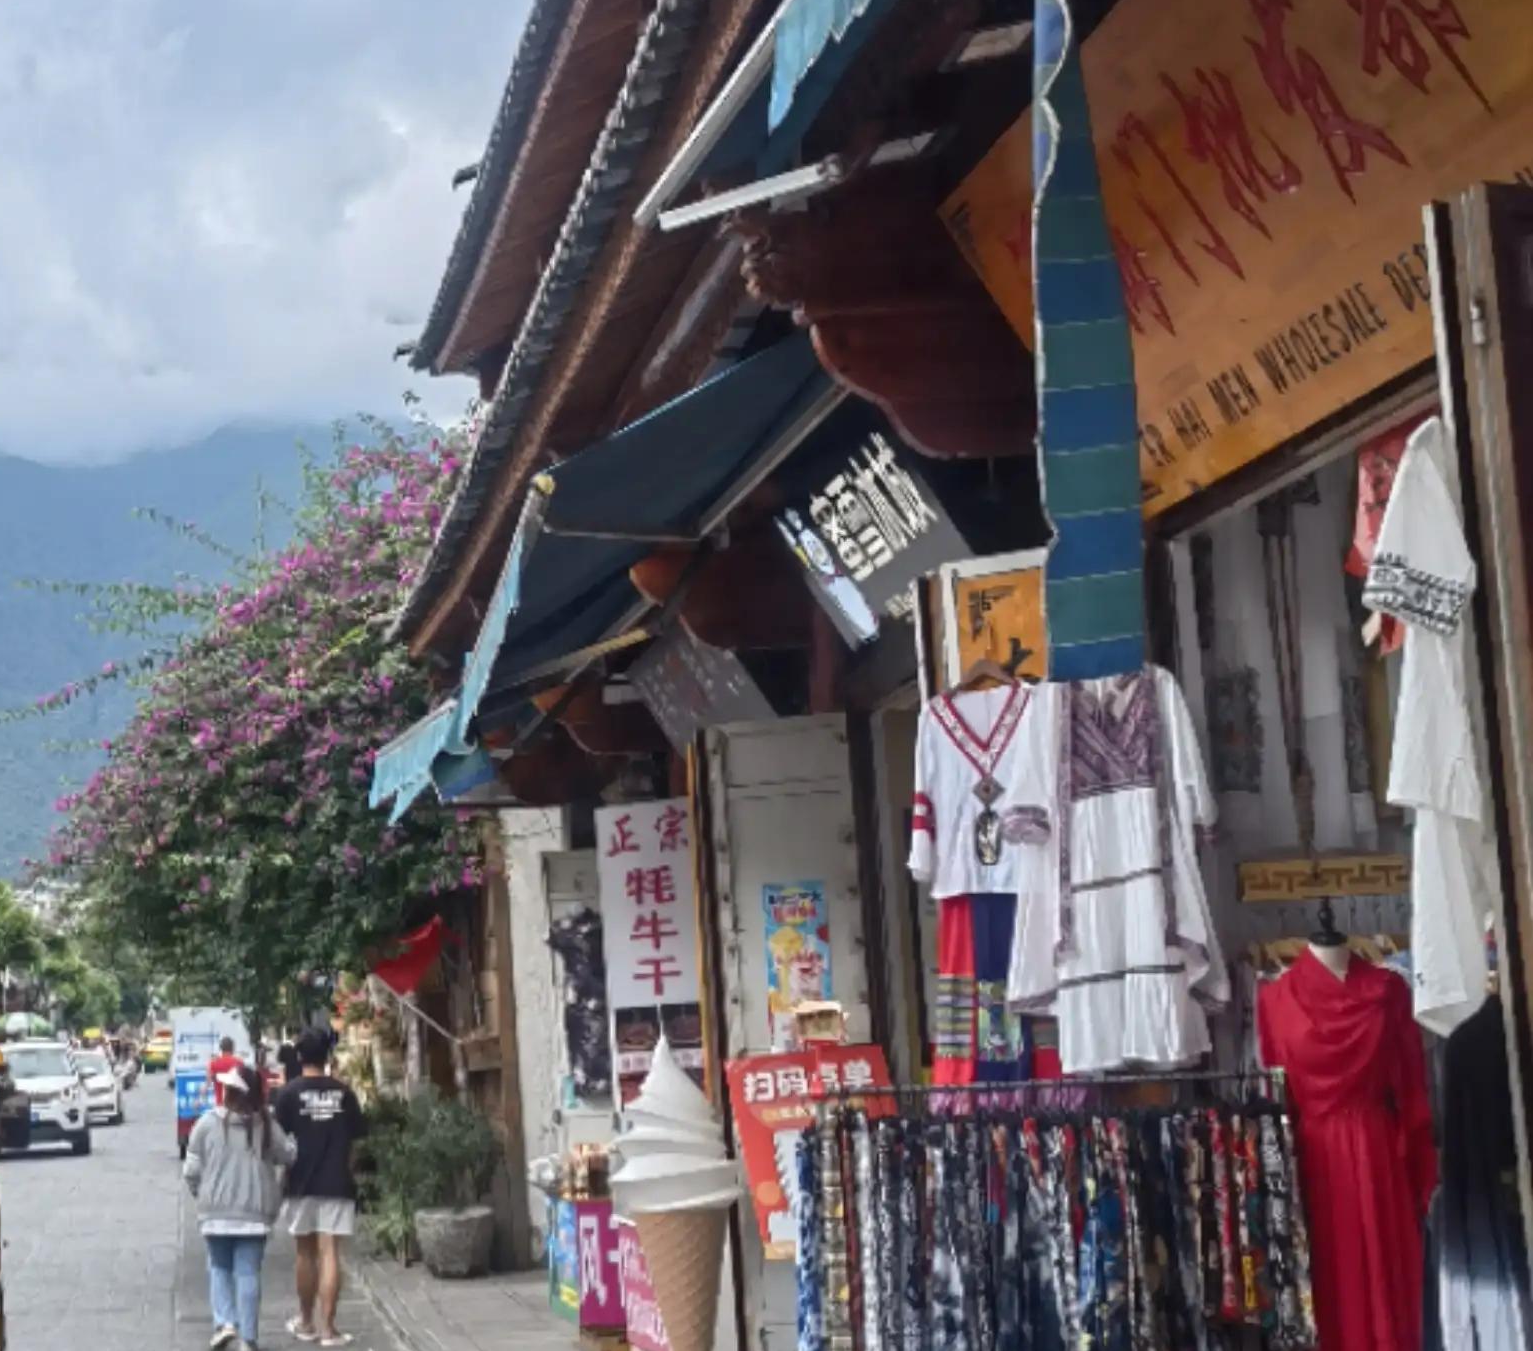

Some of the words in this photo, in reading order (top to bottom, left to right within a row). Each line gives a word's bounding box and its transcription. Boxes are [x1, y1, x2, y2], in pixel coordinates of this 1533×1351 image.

[1205, 362, 1262, 426] MEN
[1252, 282, 1388, 395] WHOLESALE
[605, 805, 689, 858] 正宗
[624, 864, 683, 997] 牦牛干
[743, 1058, 874, 1103] 扫码点单
